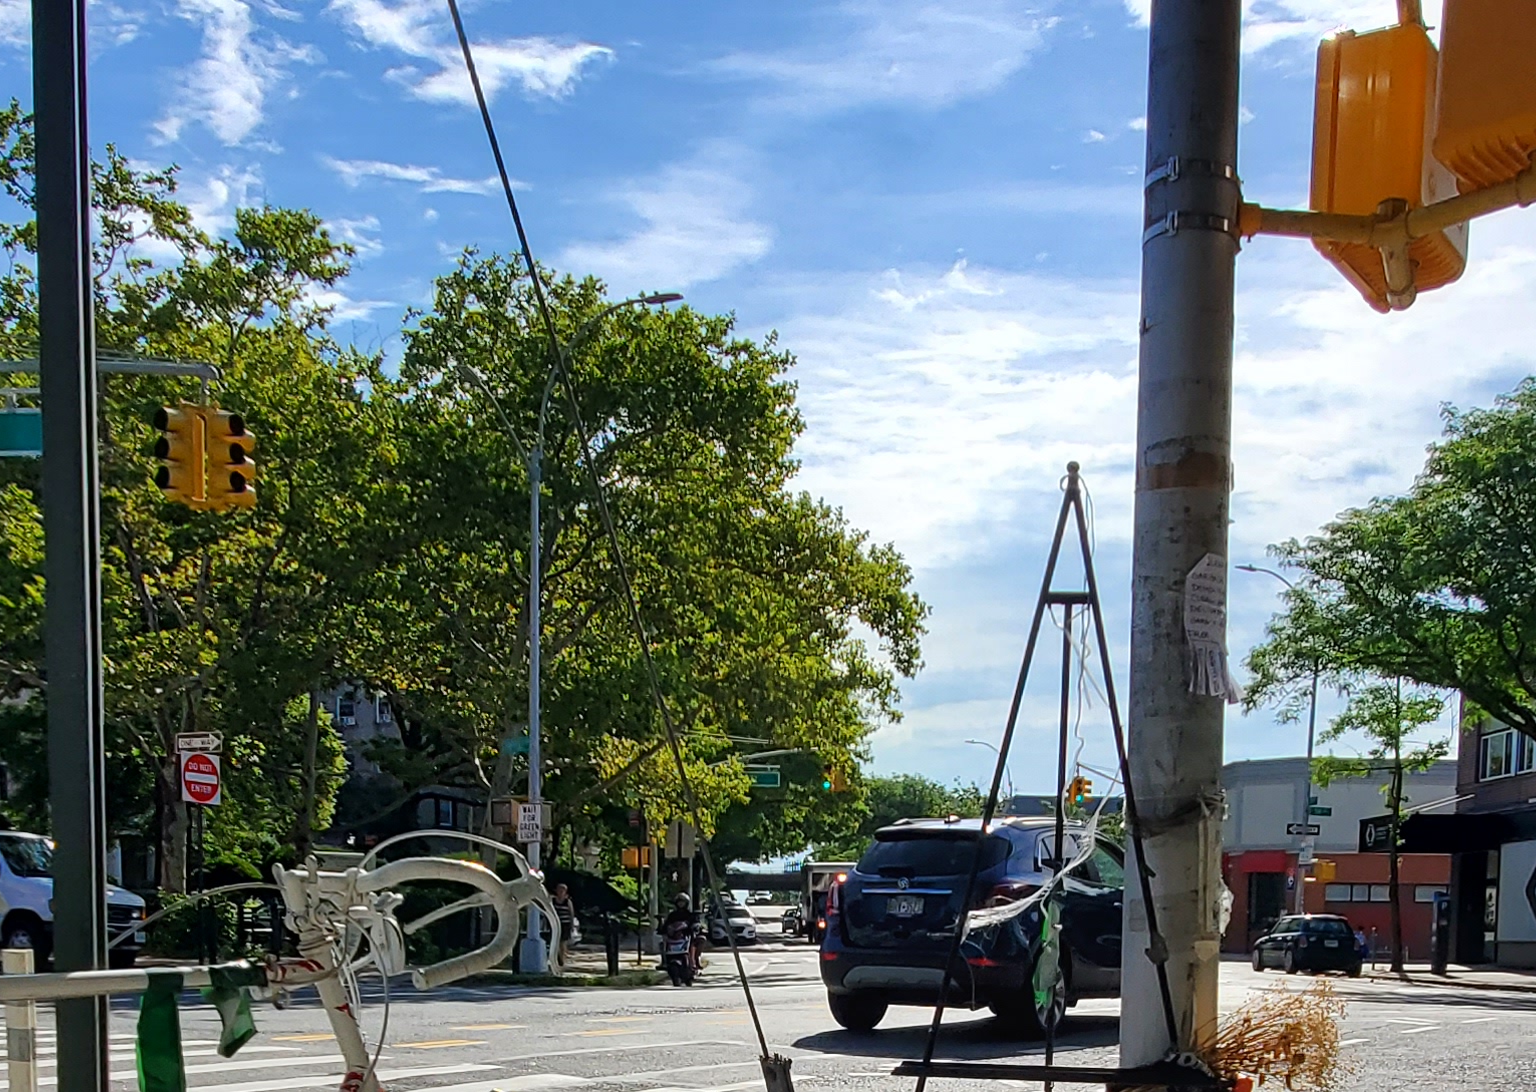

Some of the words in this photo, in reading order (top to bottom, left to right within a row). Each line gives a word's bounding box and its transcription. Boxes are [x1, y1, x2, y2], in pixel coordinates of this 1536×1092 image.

[188, 761, 198, 771] DO
[199, 763, 213, 773] NOT
[190, 783, 212, 795] ENTER
